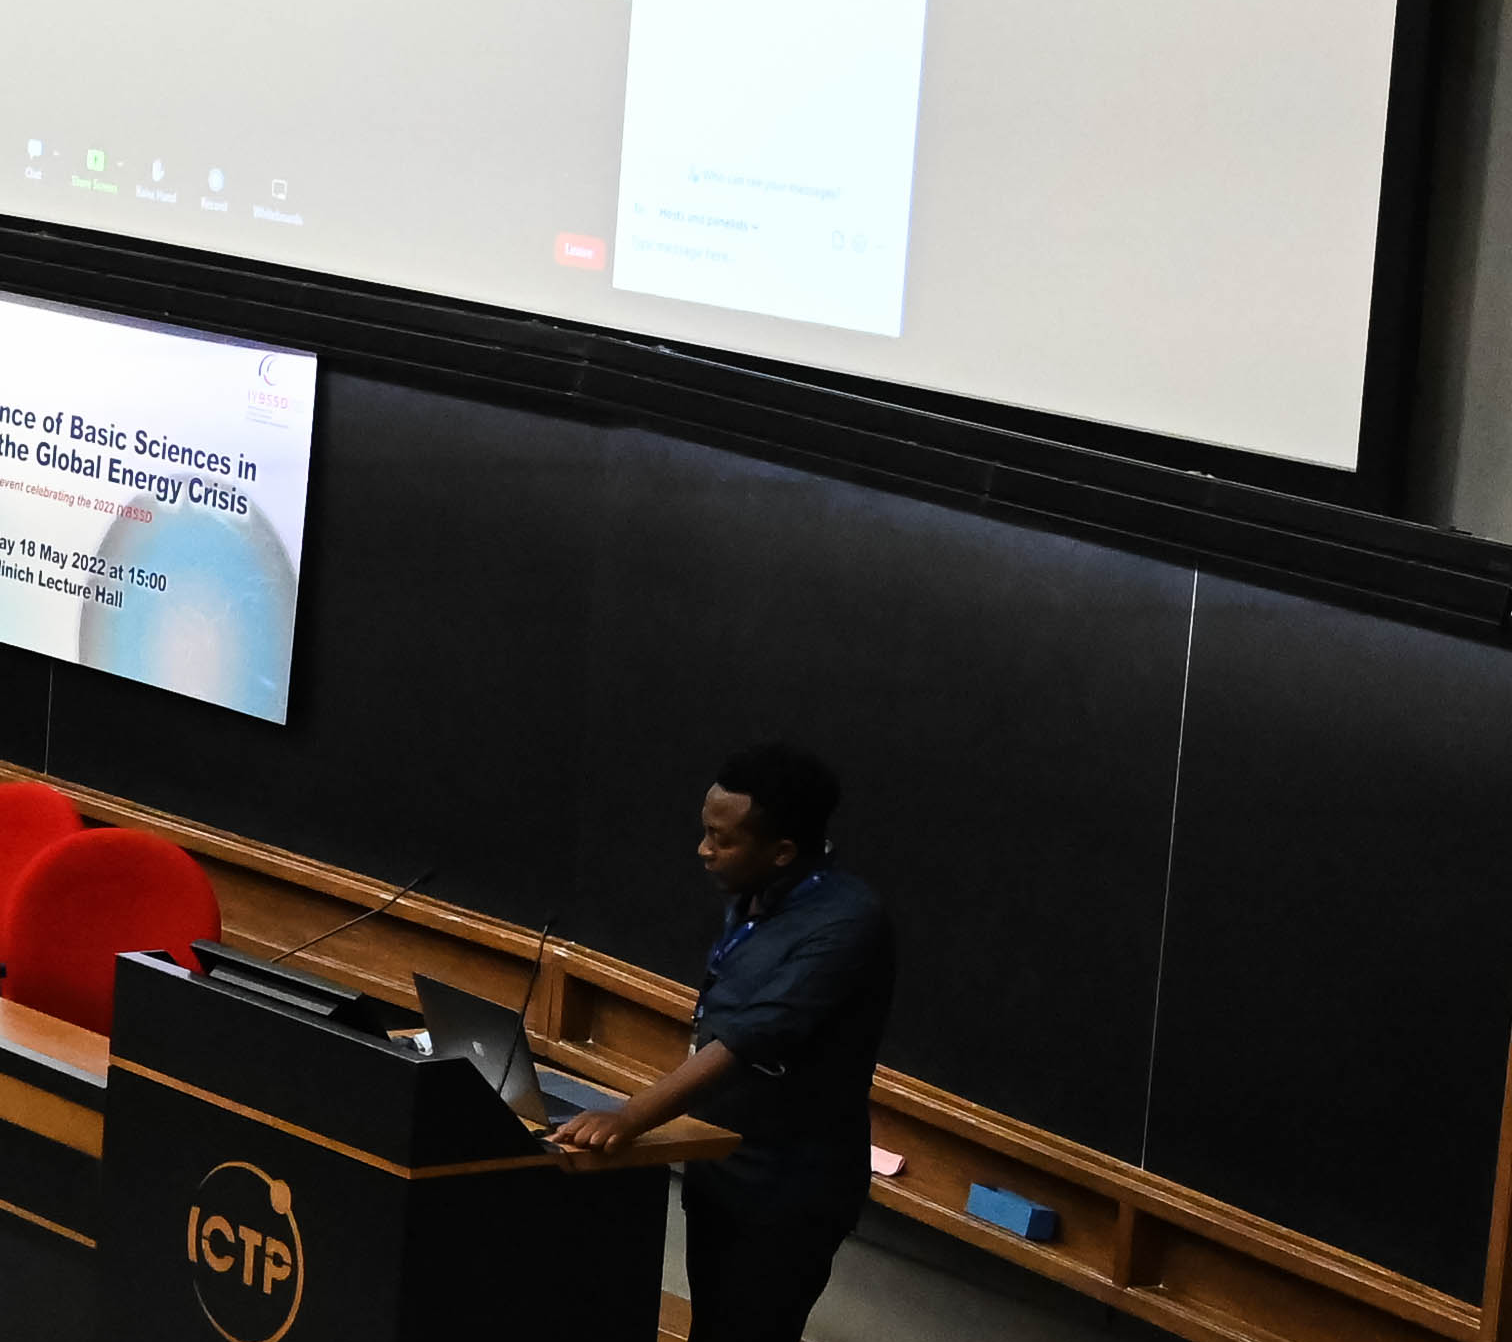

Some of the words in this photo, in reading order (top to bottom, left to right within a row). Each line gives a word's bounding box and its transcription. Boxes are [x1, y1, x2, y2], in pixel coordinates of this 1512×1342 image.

[43, 411, 64, 436] of
[70, 415, 129, 451] Basic
[134, 429, 232, 476] Sciences
[238, 452, 257, 481] in
[0, 478, 24, 493] event
[25, 483, 75, 508] celebrating
[77, 493, 92, 508] the
[94, 498, 115, 515] 2022
[116, 504, 153, 523] IYBSSD
[36, 440, 101, 480] Global
[108, 458, 184, 505] Energy
[189, 476, 249, 515] Crisis
[20, 538, 35, 557] 18
[40, 543, 68, 570] May
[71, 552, 106, 576] 2022
[109, 563, 123, 581] at
[128, 566, 167, 592] 15:00
[38, 569, 92, 599] Lecture
[94, 584, 123, 609] Hall
[186, 1203, 293, 1293] ICTP
